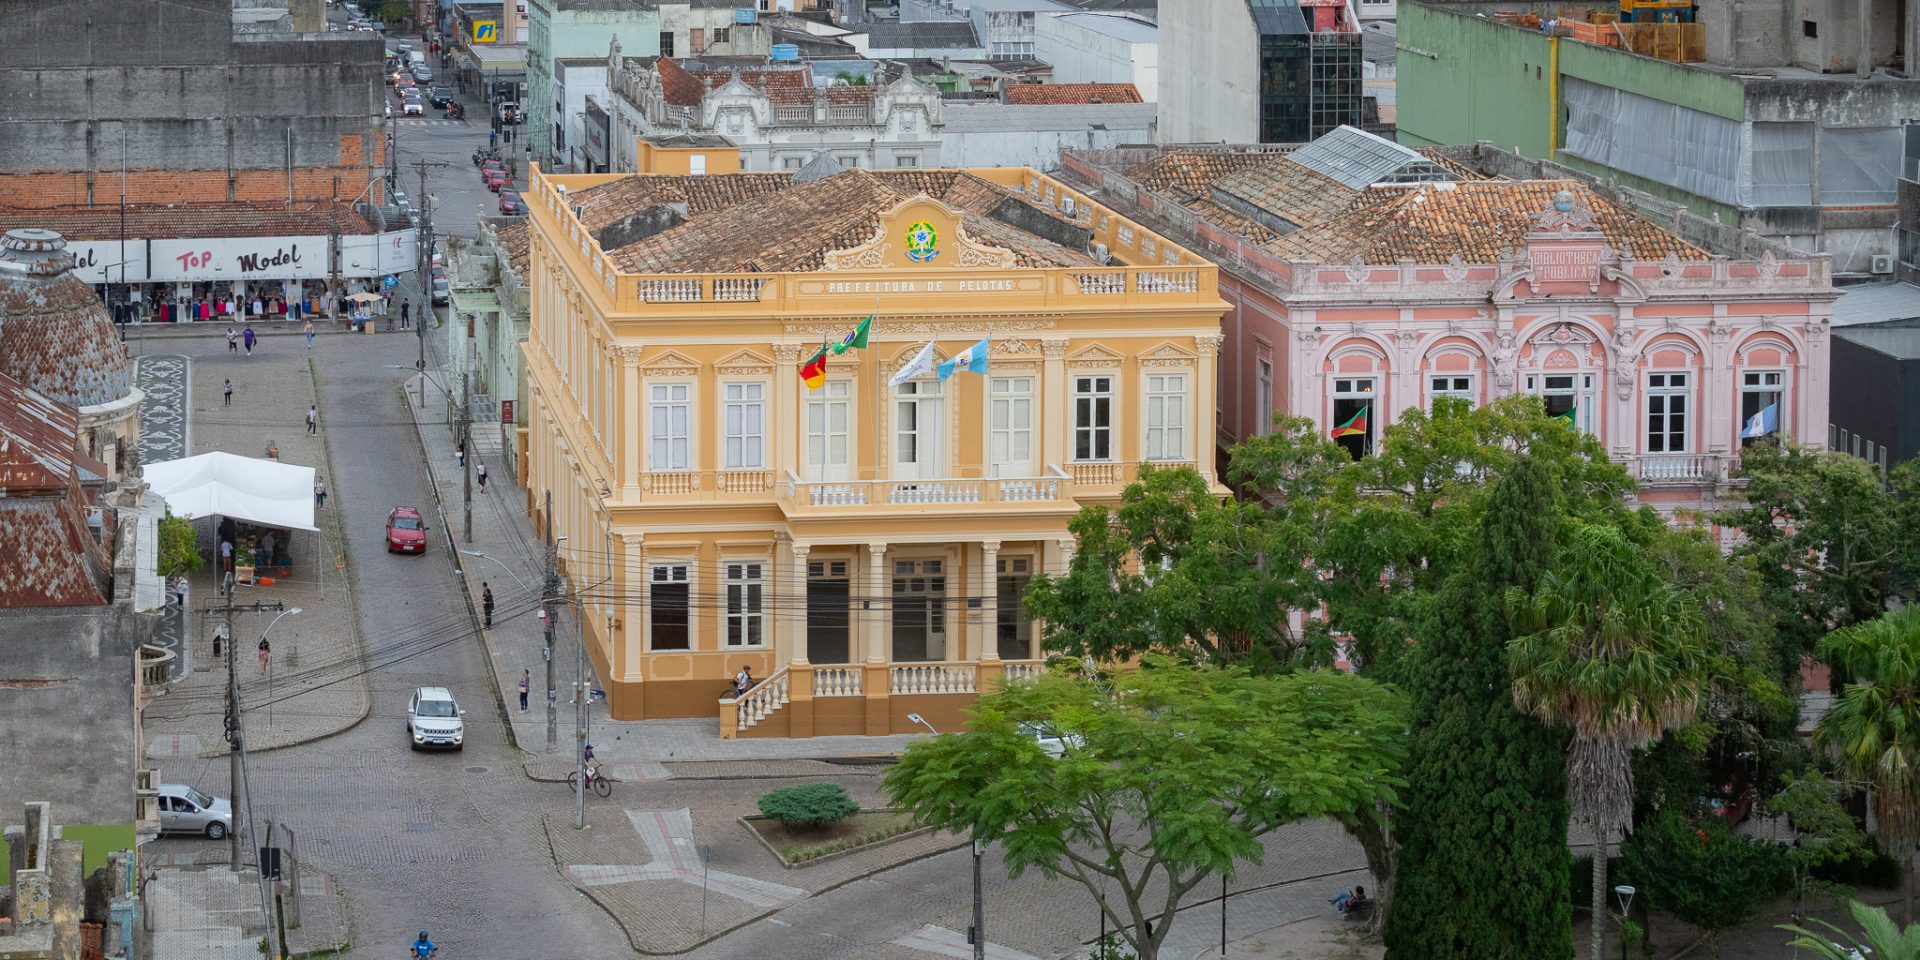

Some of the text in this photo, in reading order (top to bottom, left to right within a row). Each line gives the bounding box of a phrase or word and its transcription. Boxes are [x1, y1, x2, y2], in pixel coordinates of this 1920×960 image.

[237, 244, 301, 272] Model
[1534, 251, 1599, 265] BIBLIOTHECA
[1544, 265, 1588, 279] PUBLICA
[829, 280, 1012, 293] PREFEITURA DE PELOTAS
